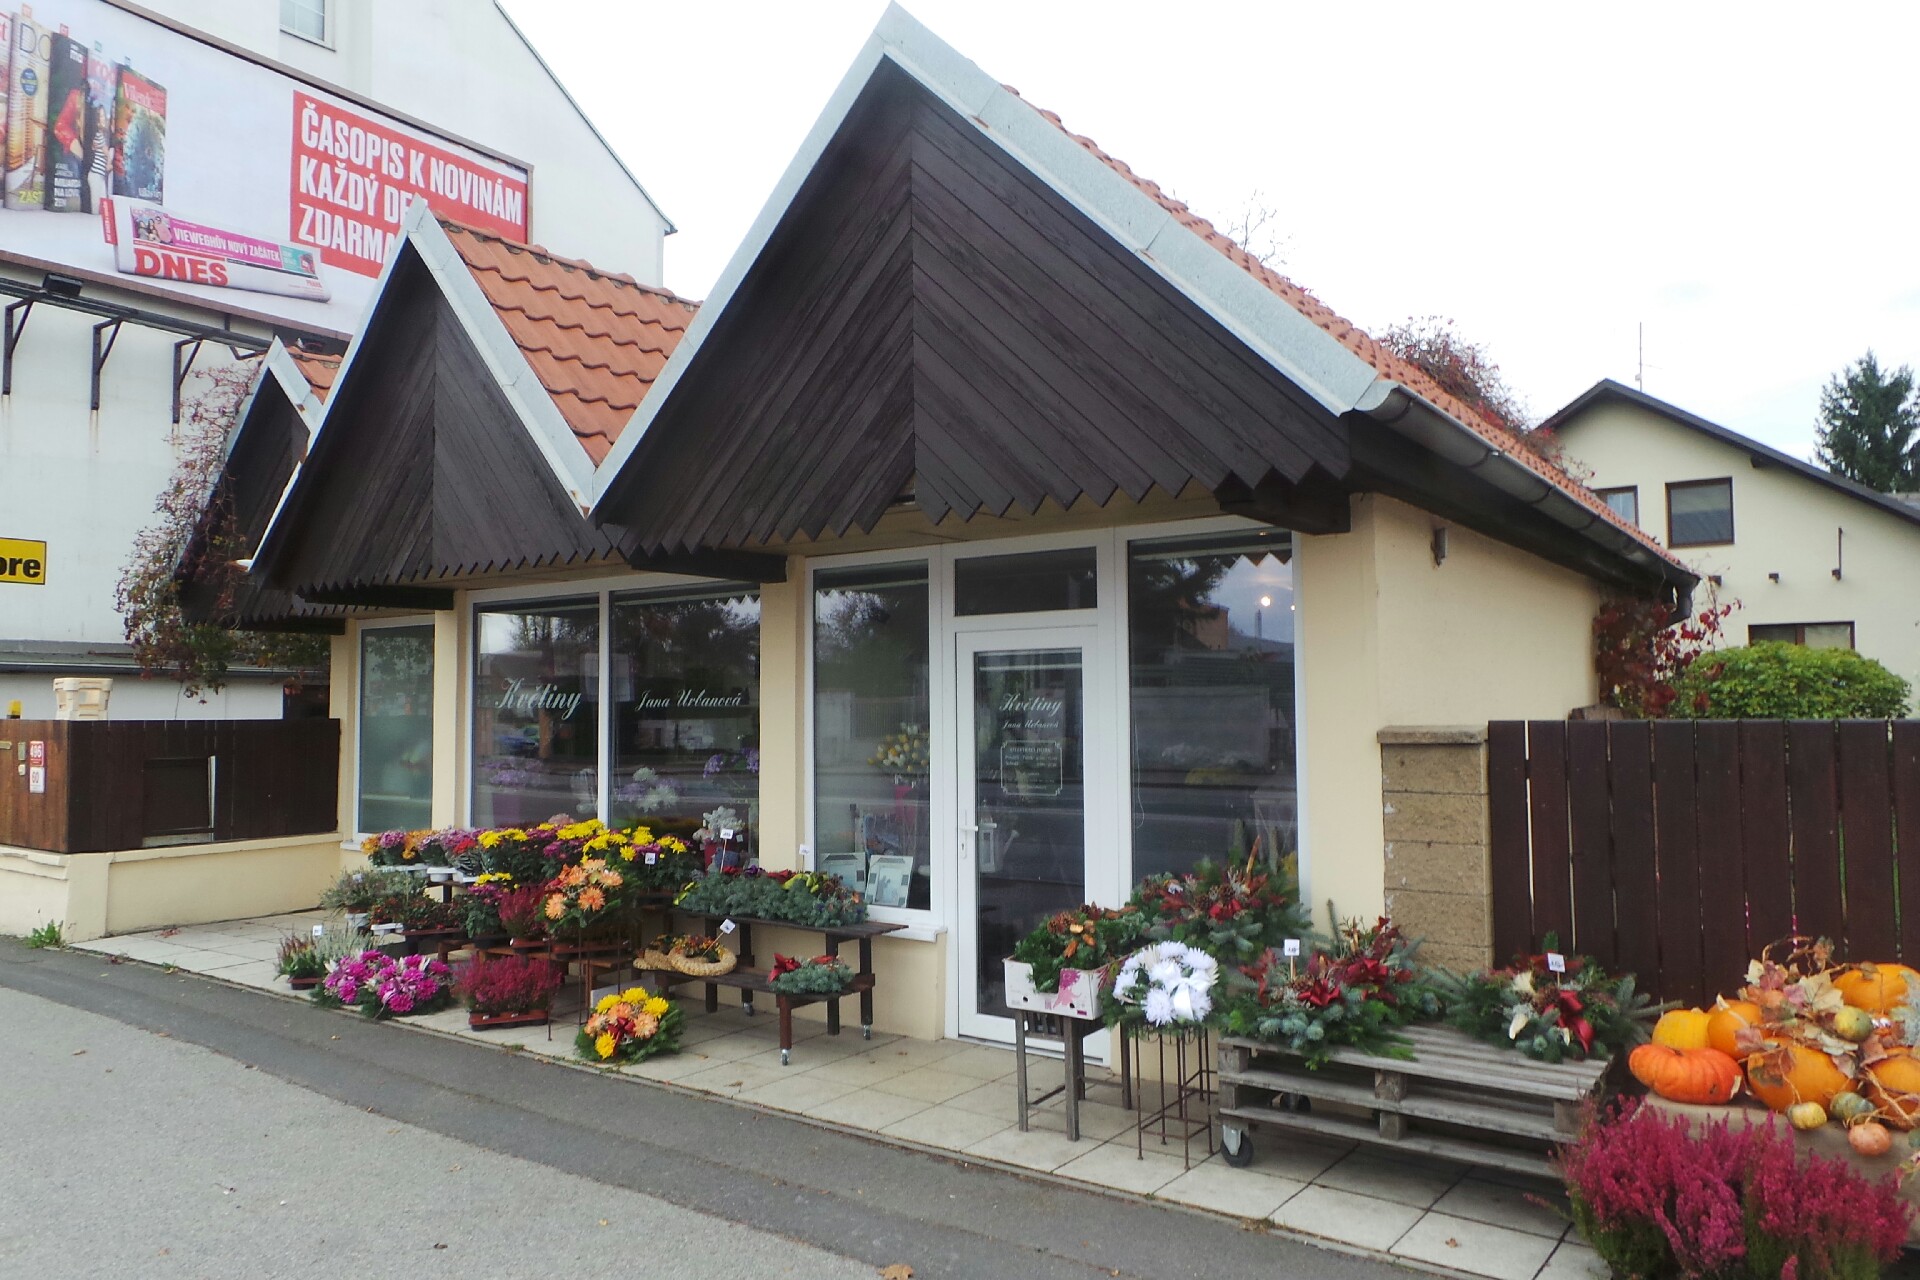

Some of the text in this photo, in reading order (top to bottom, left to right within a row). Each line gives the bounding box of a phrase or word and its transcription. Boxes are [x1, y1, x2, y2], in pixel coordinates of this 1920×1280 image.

[301, 100, 523, 226] ČASOPIS K NOVINÁM
[299, 154, 380, 216] KAŽDÝ
[173, 227, 227, 250] VIEWEGHŮV
[227, 240, 248, 256] NOVÝ
[249, 244, 281, 261] ZAČÁTEK
[134, 248, 229, 287] DNES
[495, 677, 582, 720] Květiny
[635, 688, 742, 712] Jana Urbanová
[999, 692, 1062, 717] Květiny
